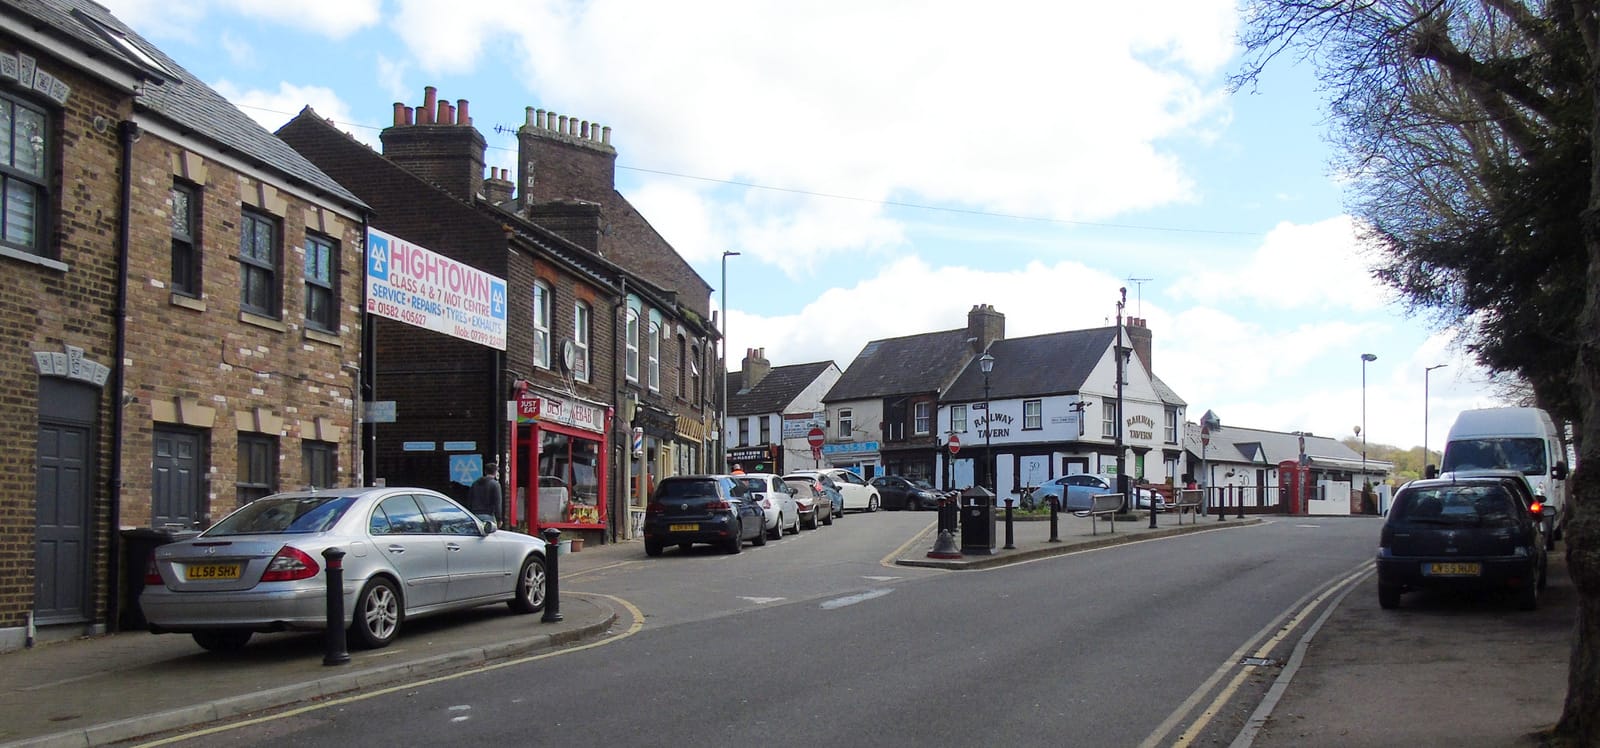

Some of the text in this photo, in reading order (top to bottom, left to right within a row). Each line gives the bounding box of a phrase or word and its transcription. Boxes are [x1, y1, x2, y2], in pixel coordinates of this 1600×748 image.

[390, 240, 490, 303] HIGHTOWN
[390, 273, 490, 317] CLASS 4 & 7 MOT CENTRE
[373, 283, 406, 305] SERVICE
[411, 295, 441, 316] REPAIRS
[446, 306, 467, 324] TYRES
[378, 302, 399, 318] 01582
[520, 400, 537, 408] JUST
[571, 403, 592, 423] KEBAB
[974, 413, 1014, 428] RALWAY
[1129, 429, 1153, 440] TAVERN
[189, 566, 238, 577] LL58 SHX
